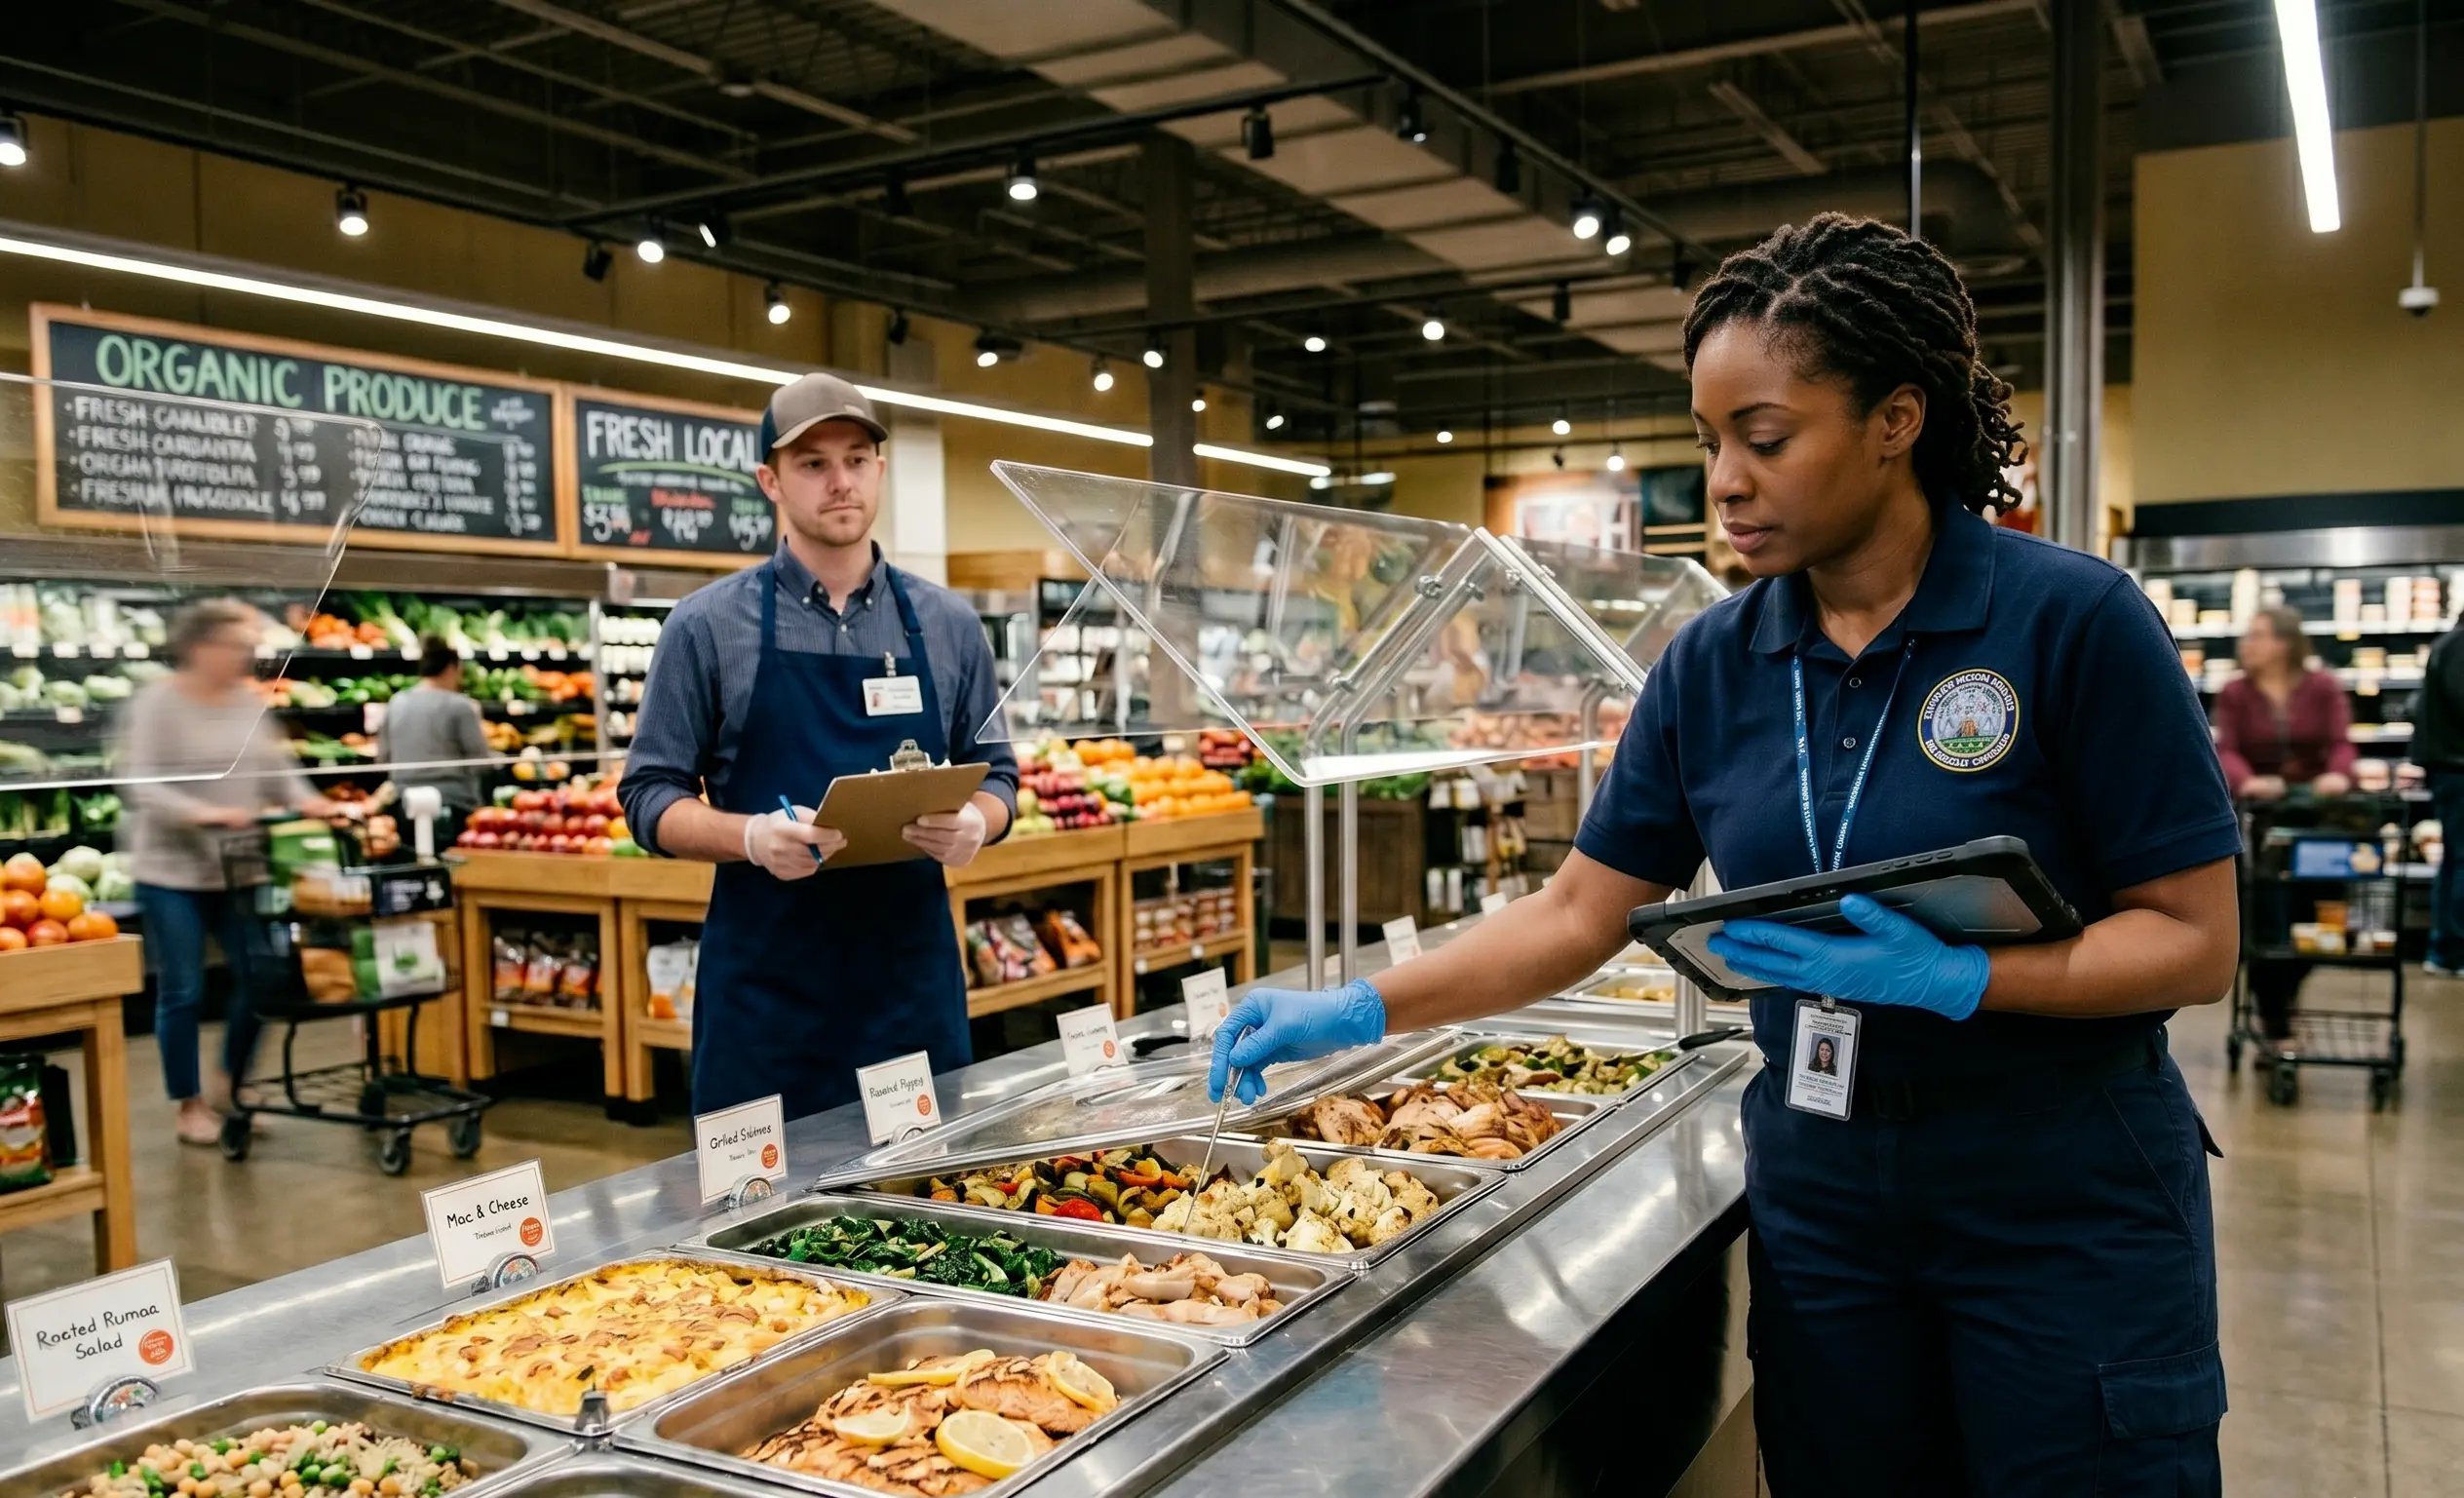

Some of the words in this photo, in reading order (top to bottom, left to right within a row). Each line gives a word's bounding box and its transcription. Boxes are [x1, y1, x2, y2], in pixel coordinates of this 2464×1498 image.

[96, 334, 303, 408] ORGANIC
[324, 365, 486, 431] PRODUCE
[75, 396, 148, 427] FRESH
[586, 409, 674, 462] FRESH
[446, 1212, 474, 1229] Mac
[477, 1204, 485, 1219] &
[488, 1195, 529, 1214] Cheese
[103, 1304, 161, 1329] Rumaa
[75, 1332, 123, 1360] Salad
